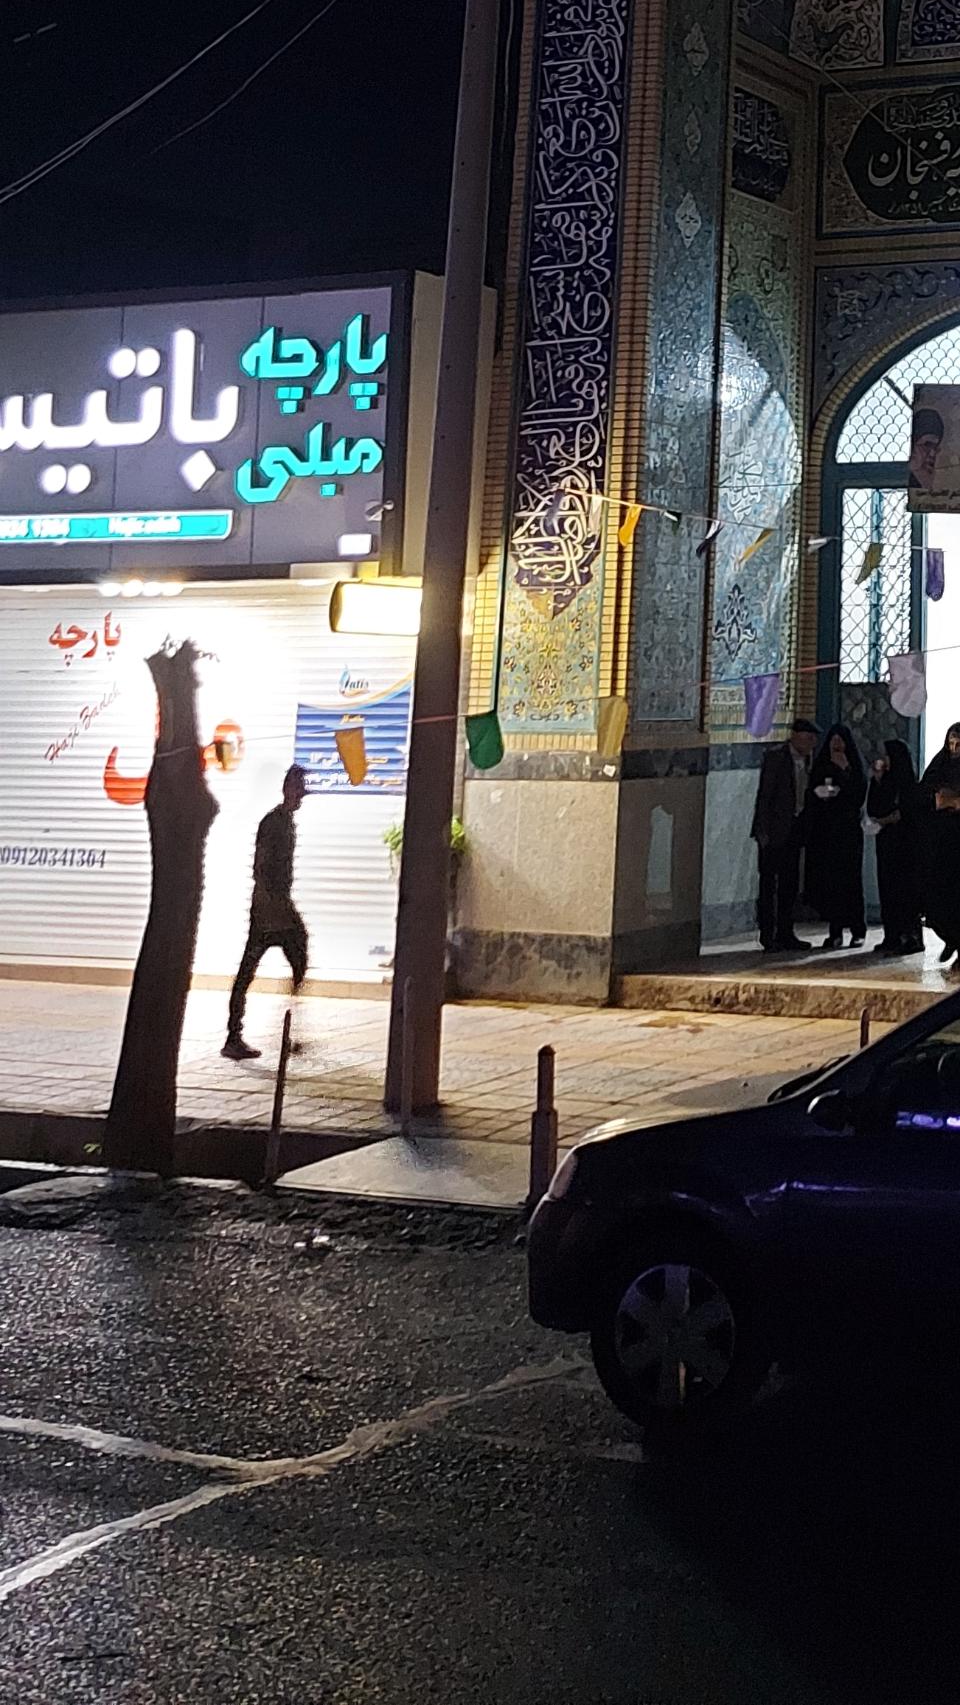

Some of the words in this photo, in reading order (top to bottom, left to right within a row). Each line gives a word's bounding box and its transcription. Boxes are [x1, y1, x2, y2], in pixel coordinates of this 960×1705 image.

[240, 313, 388, 414] پارچه
[235, 422, 384, 504] مبلی
[47, 610, 122, 667] پارچه
